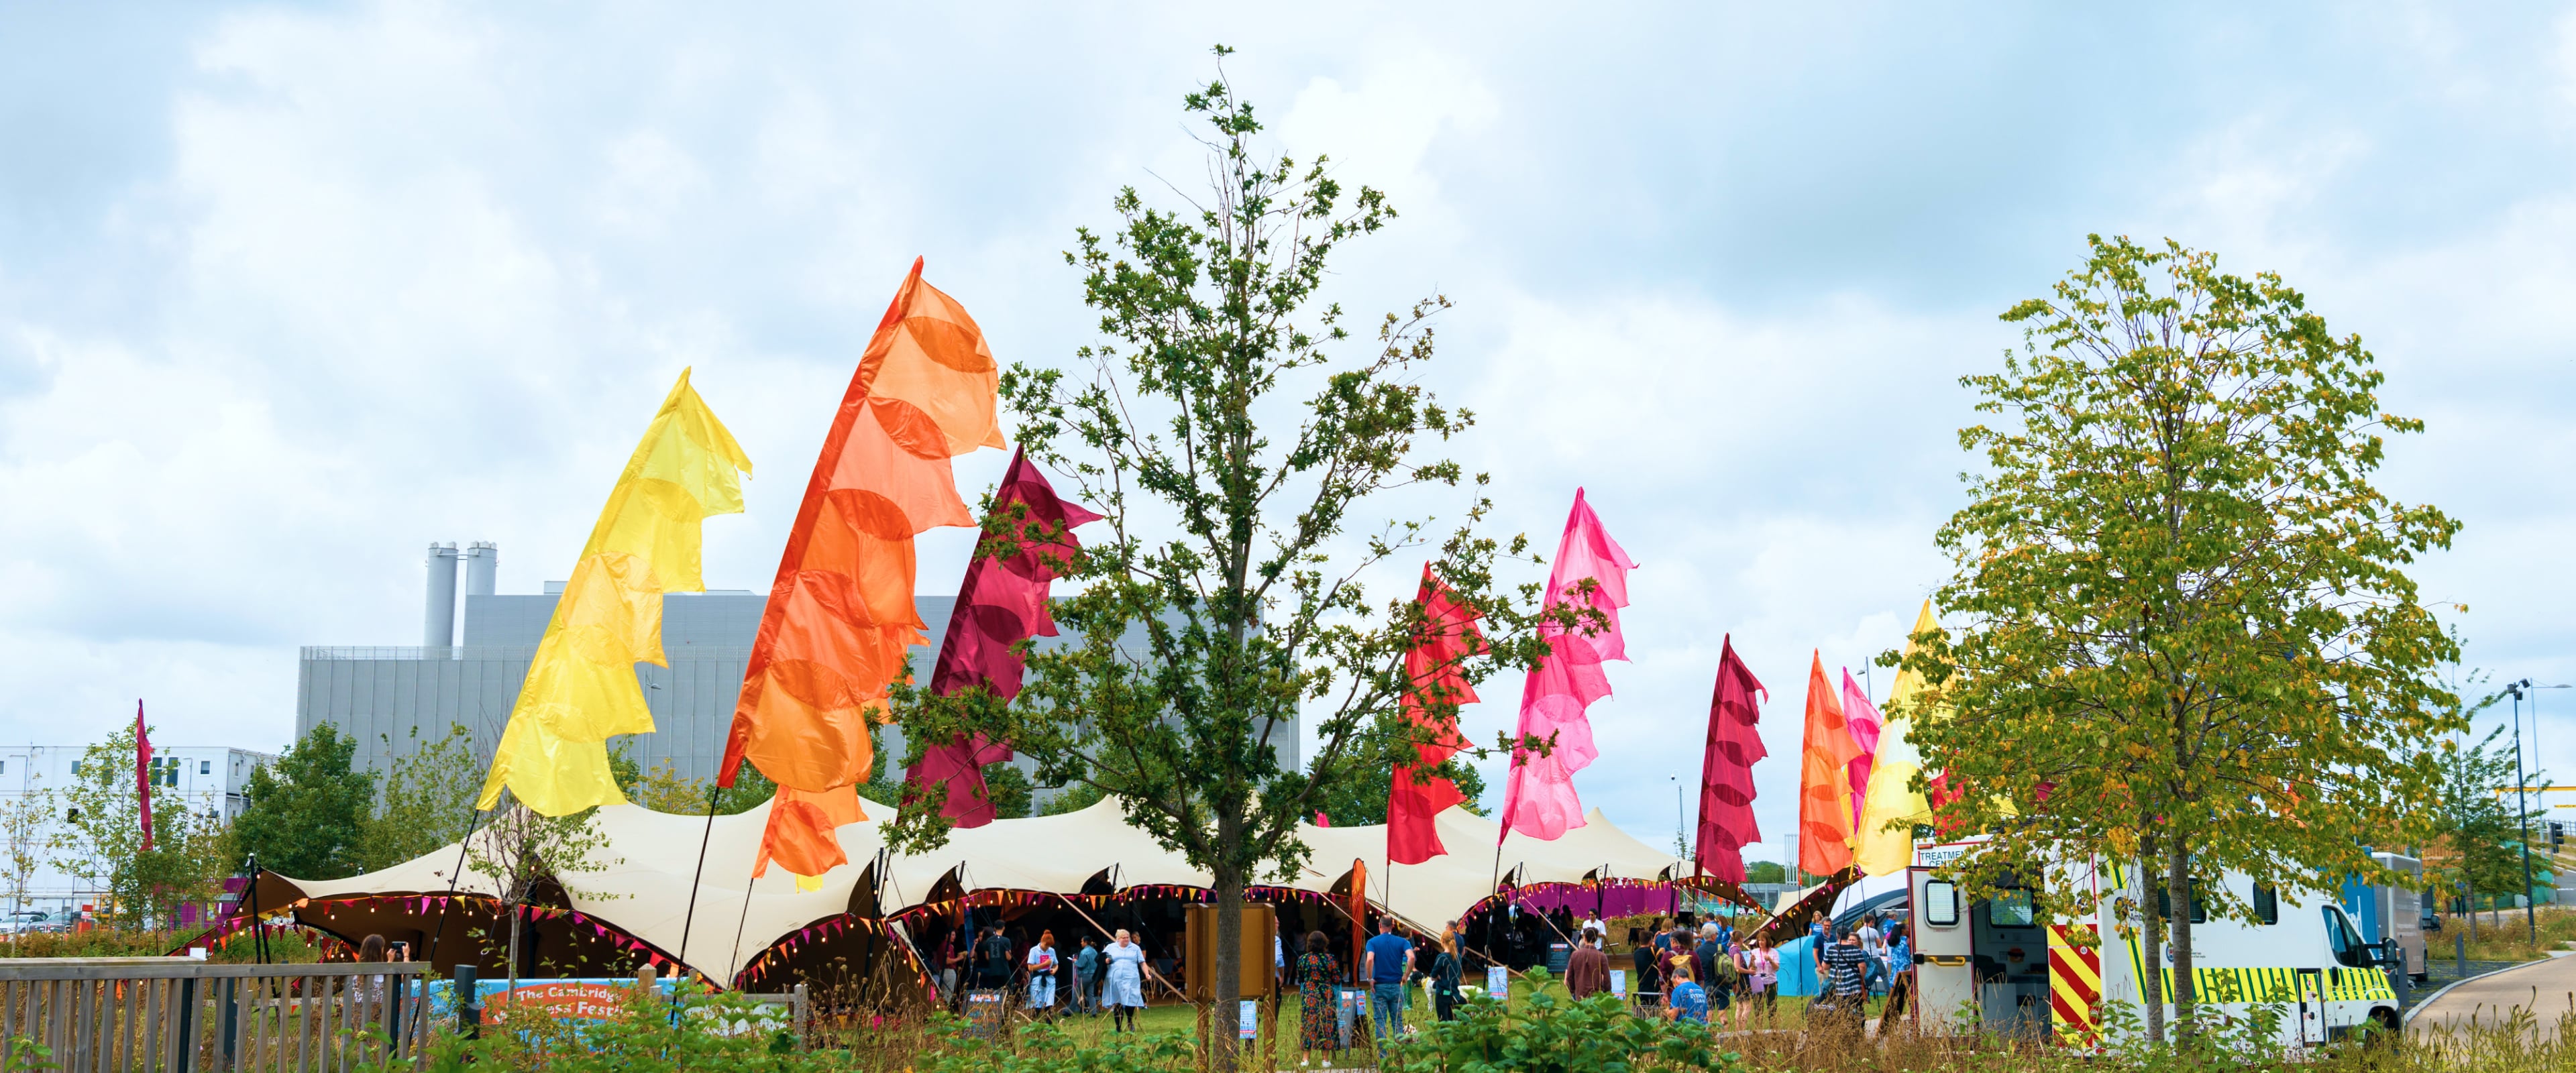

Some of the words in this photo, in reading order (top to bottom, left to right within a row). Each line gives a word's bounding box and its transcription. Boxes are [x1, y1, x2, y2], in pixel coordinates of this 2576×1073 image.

[516, 989, 544, 1001] The
[547, 986, 622, 1003] Cambridge
[578, 1001, 634, 1017] Festi
